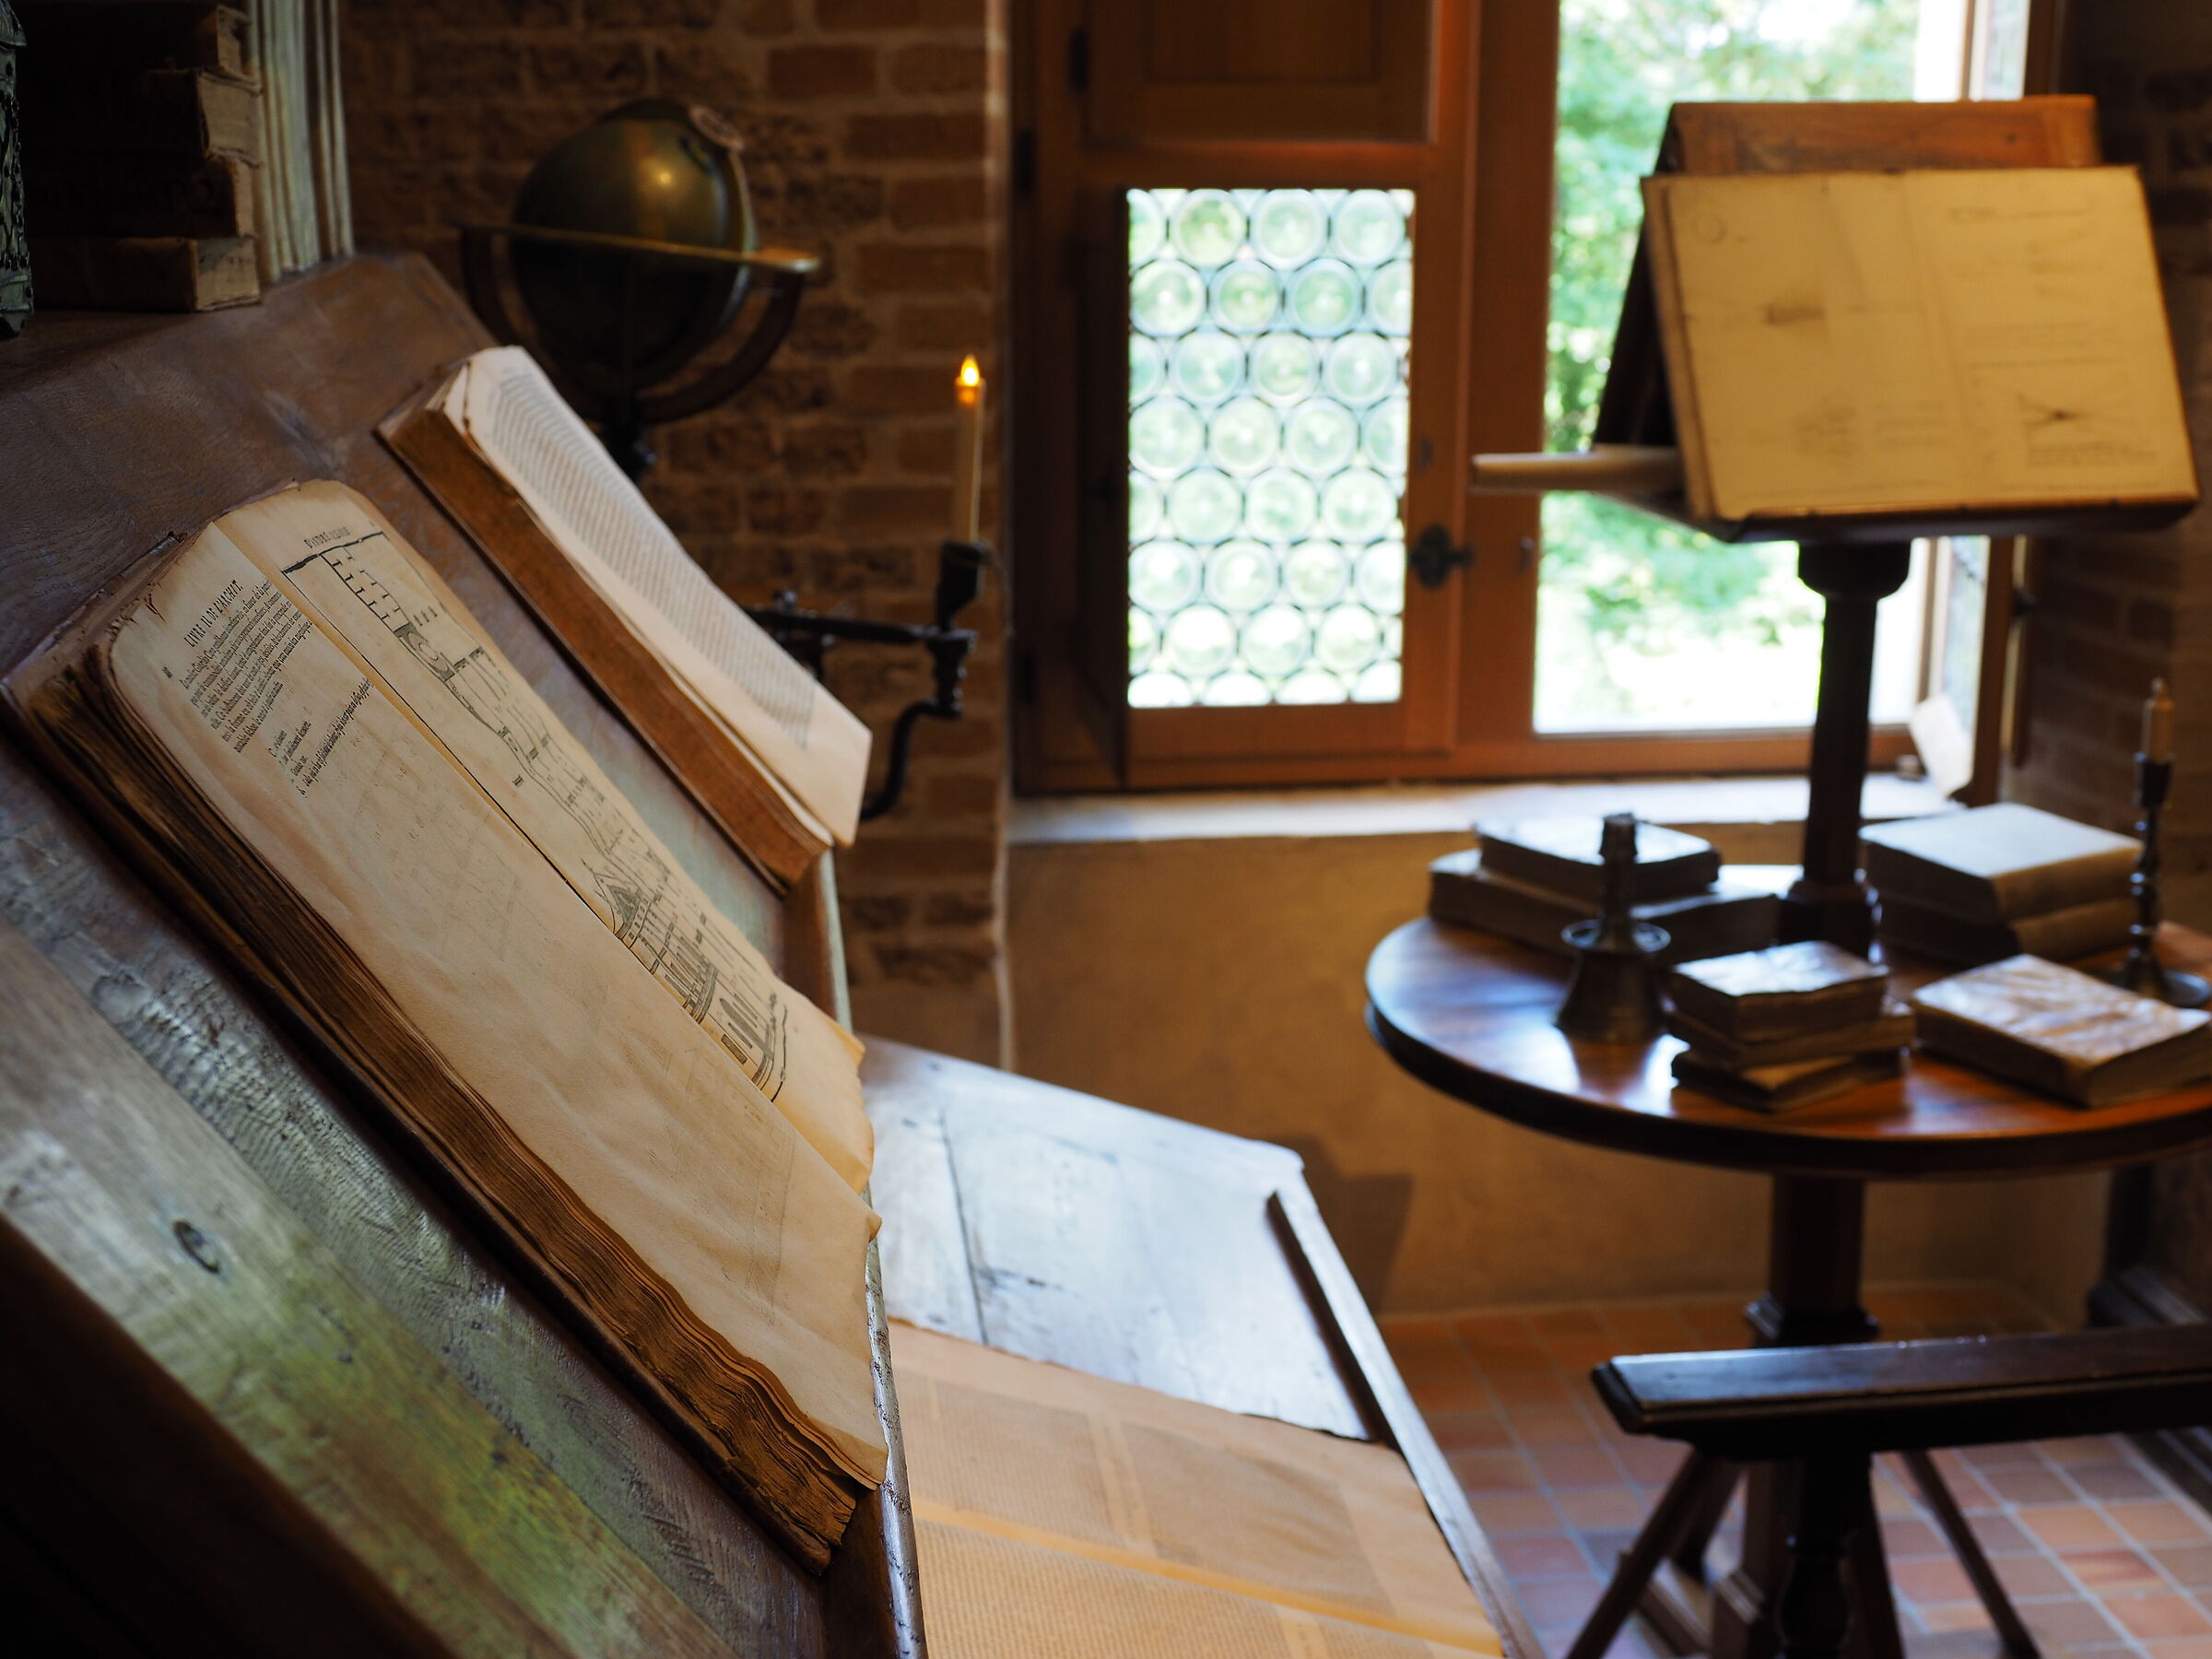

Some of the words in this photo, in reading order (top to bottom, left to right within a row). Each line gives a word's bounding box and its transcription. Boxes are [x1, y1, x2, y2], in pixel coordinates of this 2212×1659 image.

[183, 624, 206, 647] LIVRE
[206, 607, 218, 620] DE
[213, 580, 242, 613] L'ARCHIT.
